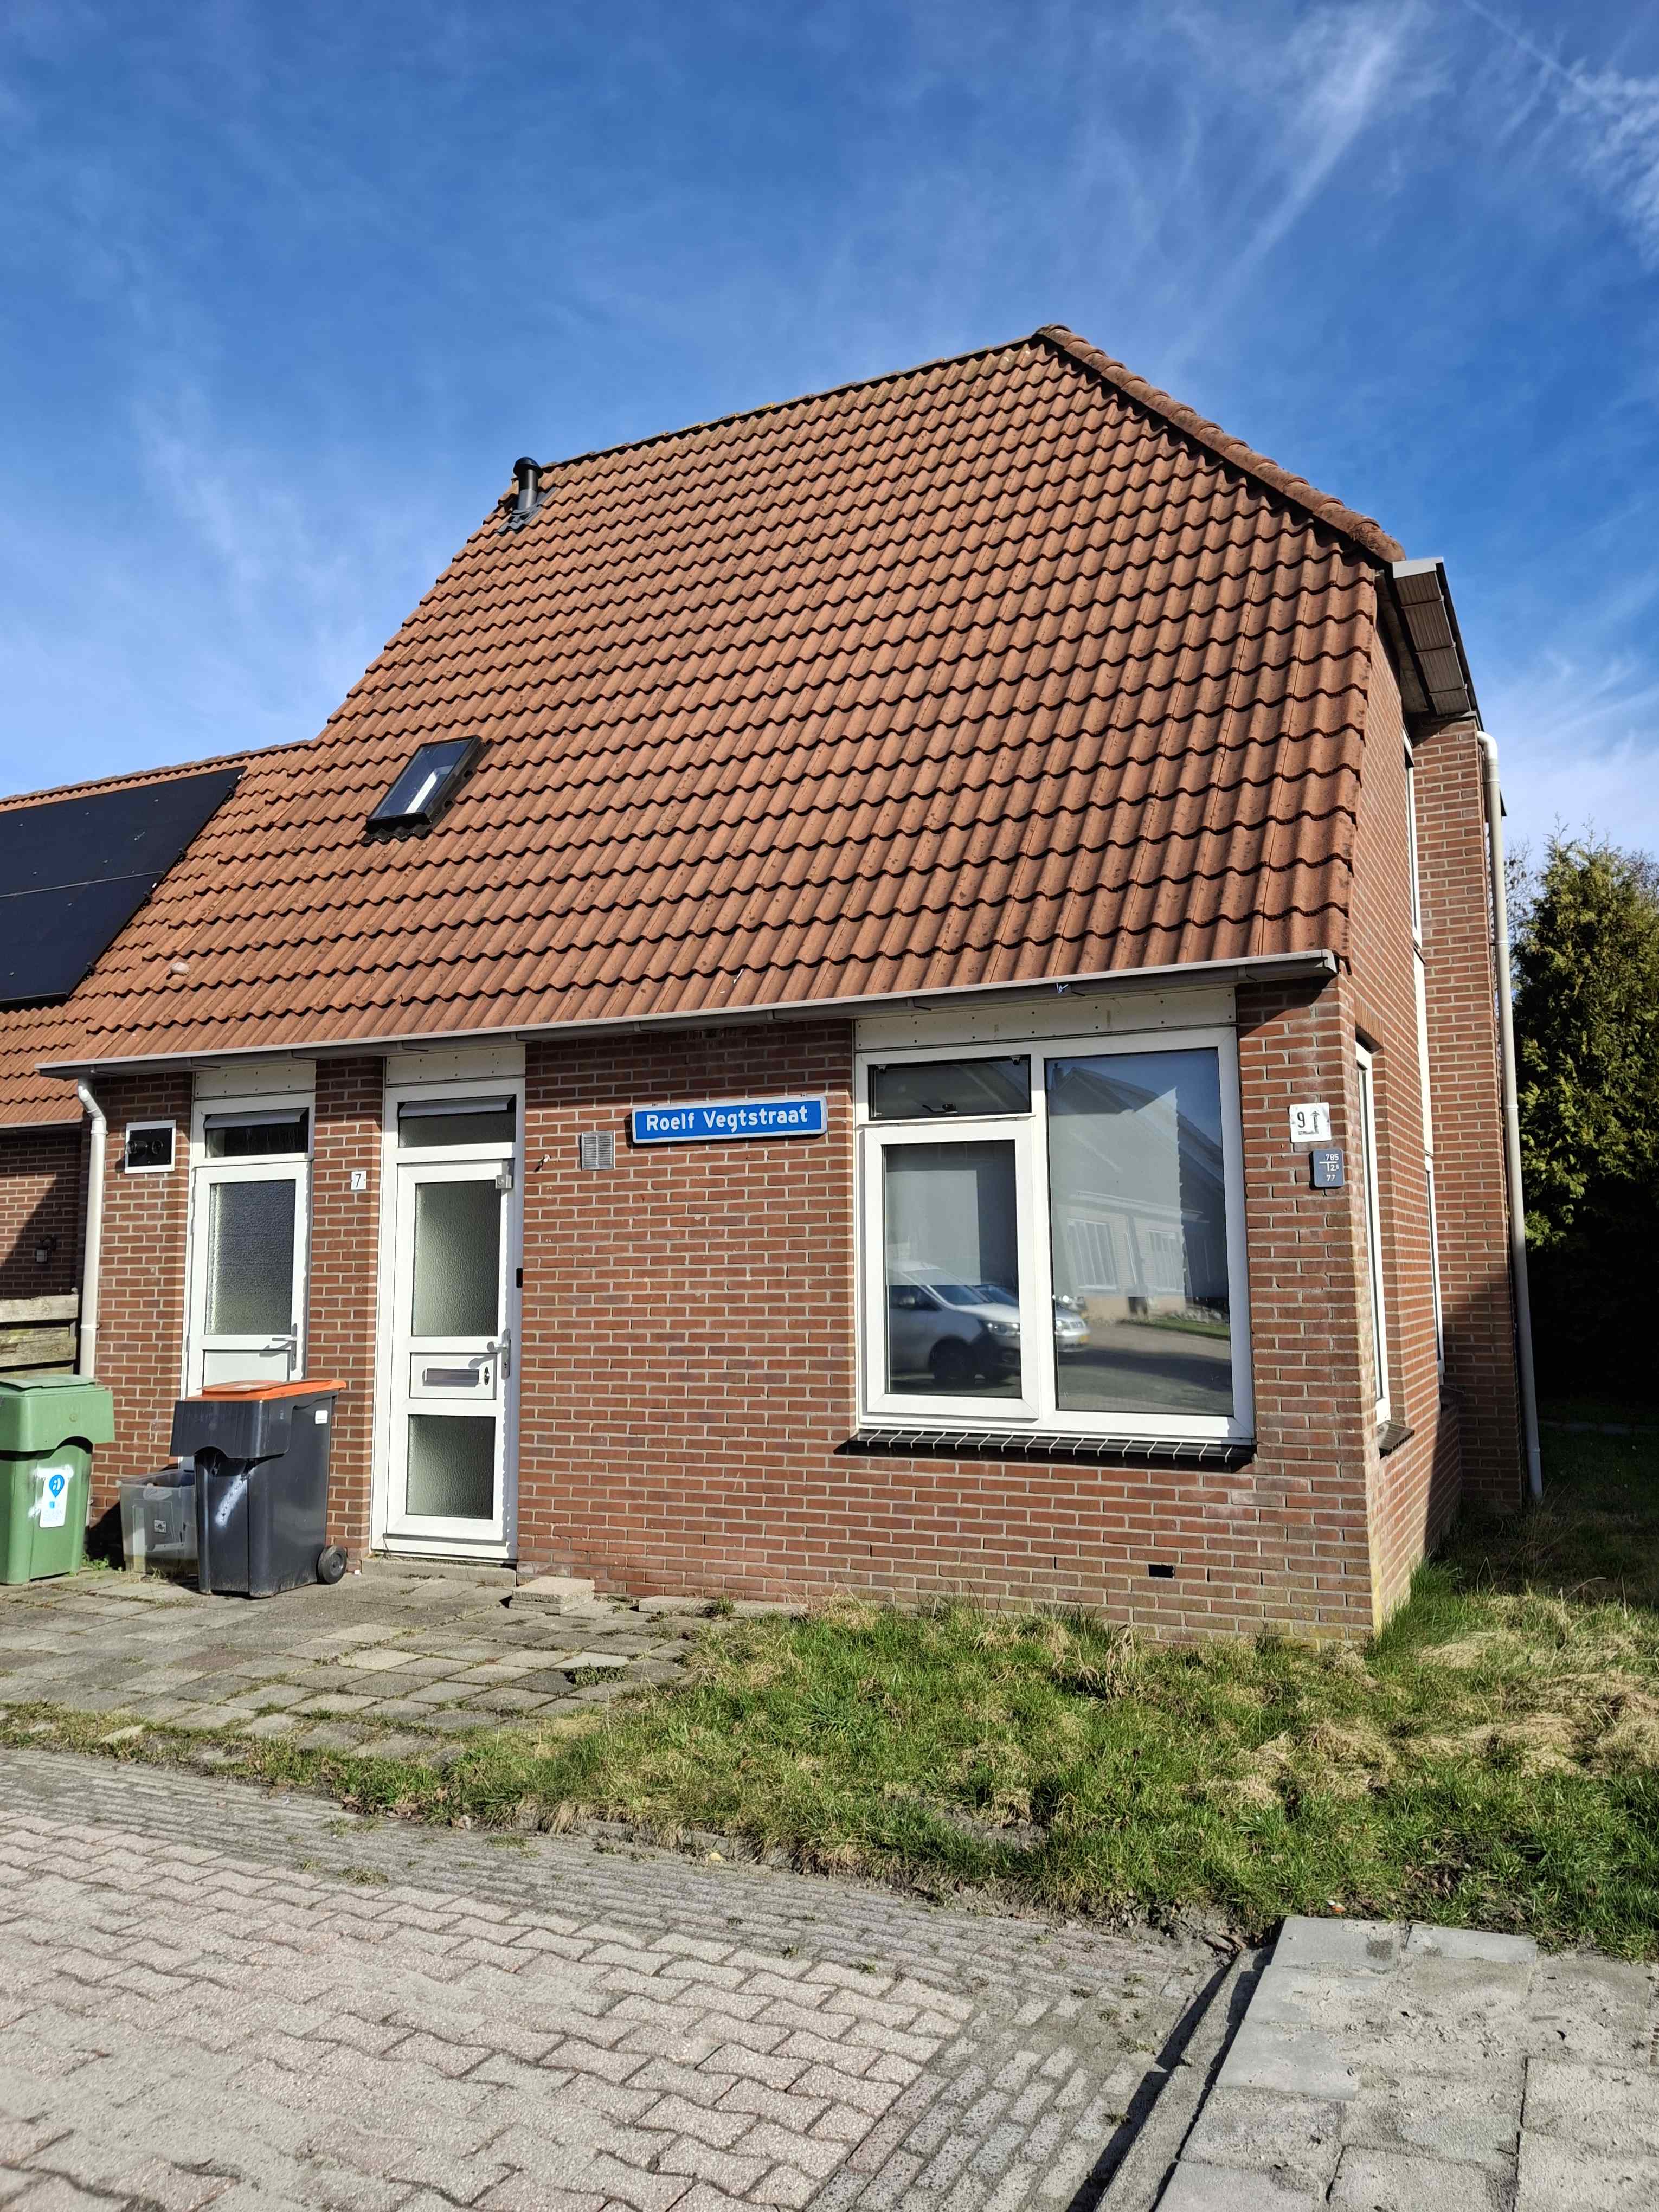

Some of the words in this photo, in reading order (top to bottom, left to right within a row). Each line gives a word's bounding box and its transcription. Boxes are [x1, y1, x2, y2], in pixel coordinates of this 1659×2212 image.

[647, 1113, 694, 1131] Roelf
[703, 1105, 807, 1133] Vegtstraat
[1297, 1111, 1305, 1128] 9
[355, 1173, 361, 1187] 7
